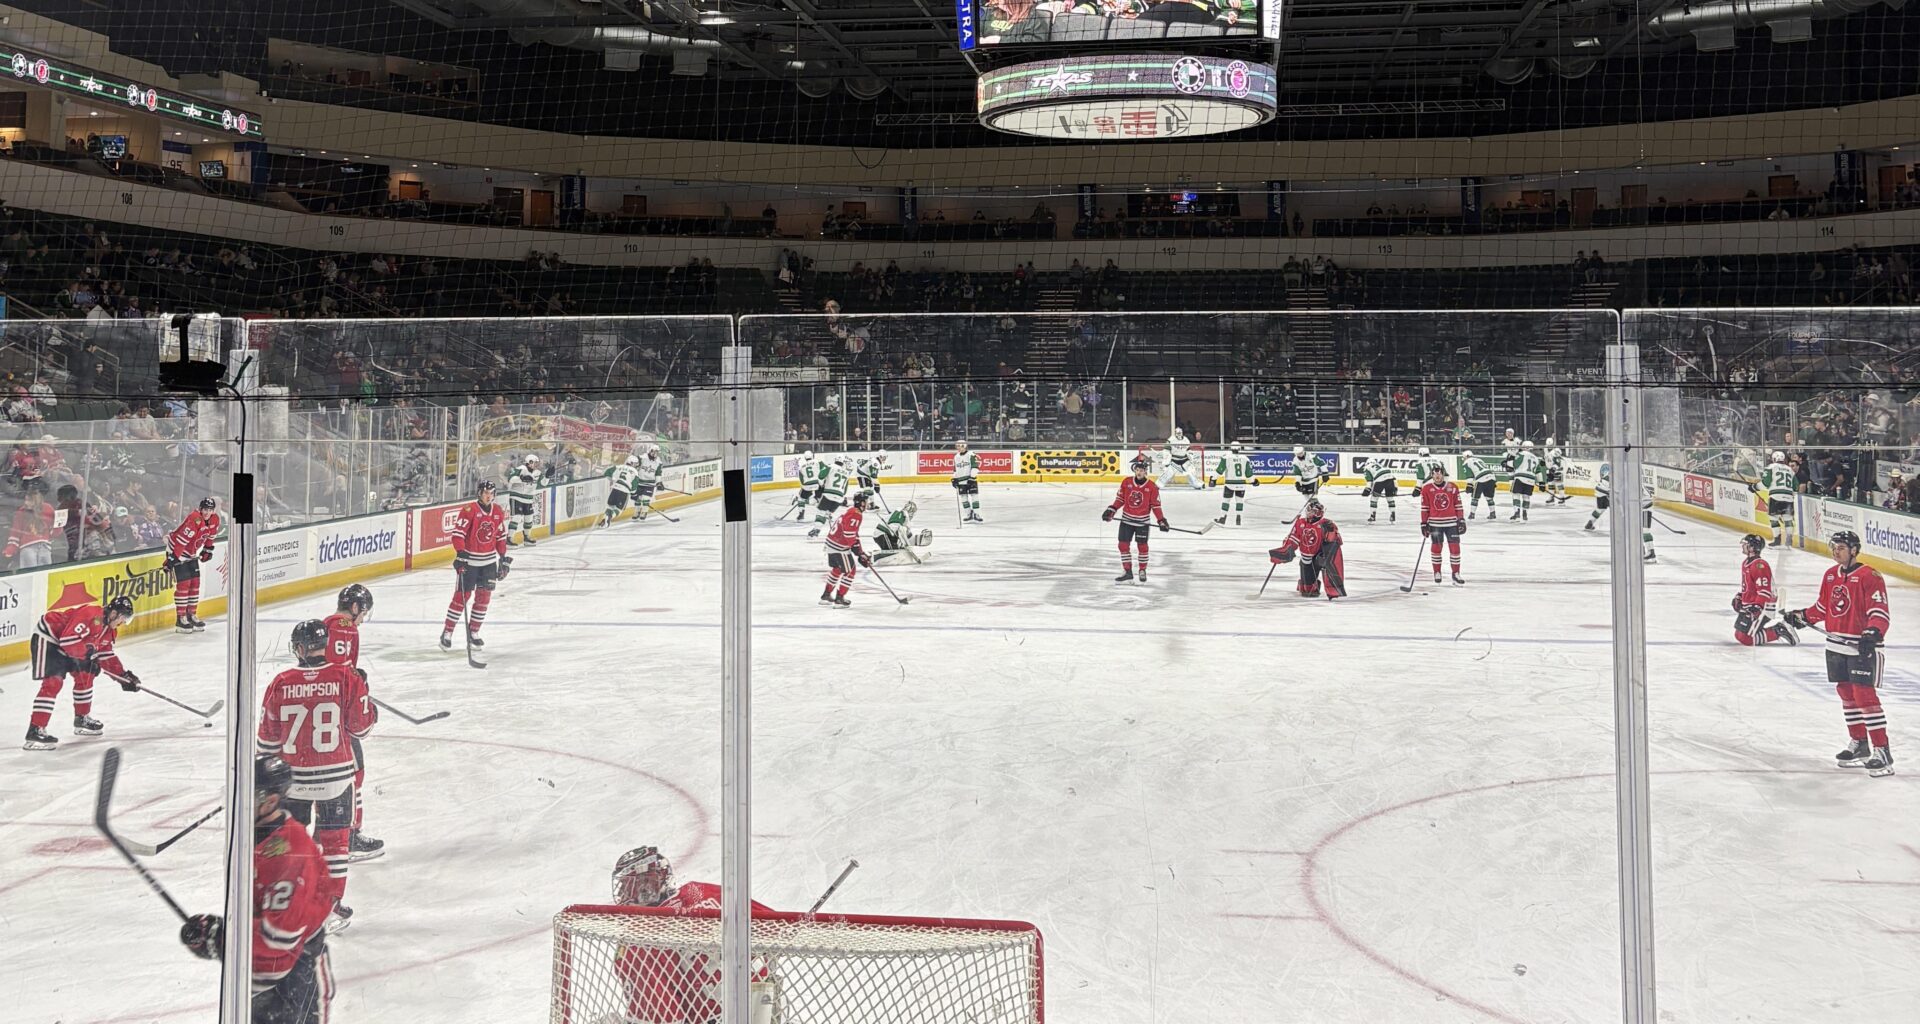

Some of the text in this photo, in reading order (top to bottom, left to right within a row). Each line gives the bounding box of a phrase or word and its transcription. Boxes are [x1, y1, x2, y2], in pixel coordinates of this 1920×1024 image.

[960, 0, 972, 42] TRA
[1031, 60, 1094, 96] TEXAS
[329, 225, 344, 237] 109
[1821, 226, 1834, 236] 114
[624, 244, 638, 253] 110
[923, 250, 935, 258] 111
[1162, 247, 1177, 256] 112
[1378, 244, 1393, 254] 113
[983, 458, 1011, 467] SHOP
[1041, 459, 1099, 467] theParkingSpot
[1235, 463, 1243, 477] 8
[1775, 471, 1793, 488] 26
[263, 540, 299, 555] ORTHOPEDICS
[319, 529, 396, 563] ticketmaster
[1755, 577, 1768, 587] 42
[102, 574, 146, 607] Pizza
[282, 682, 340, 700] THOMPSON
[280, 702, 341, 755] 78
